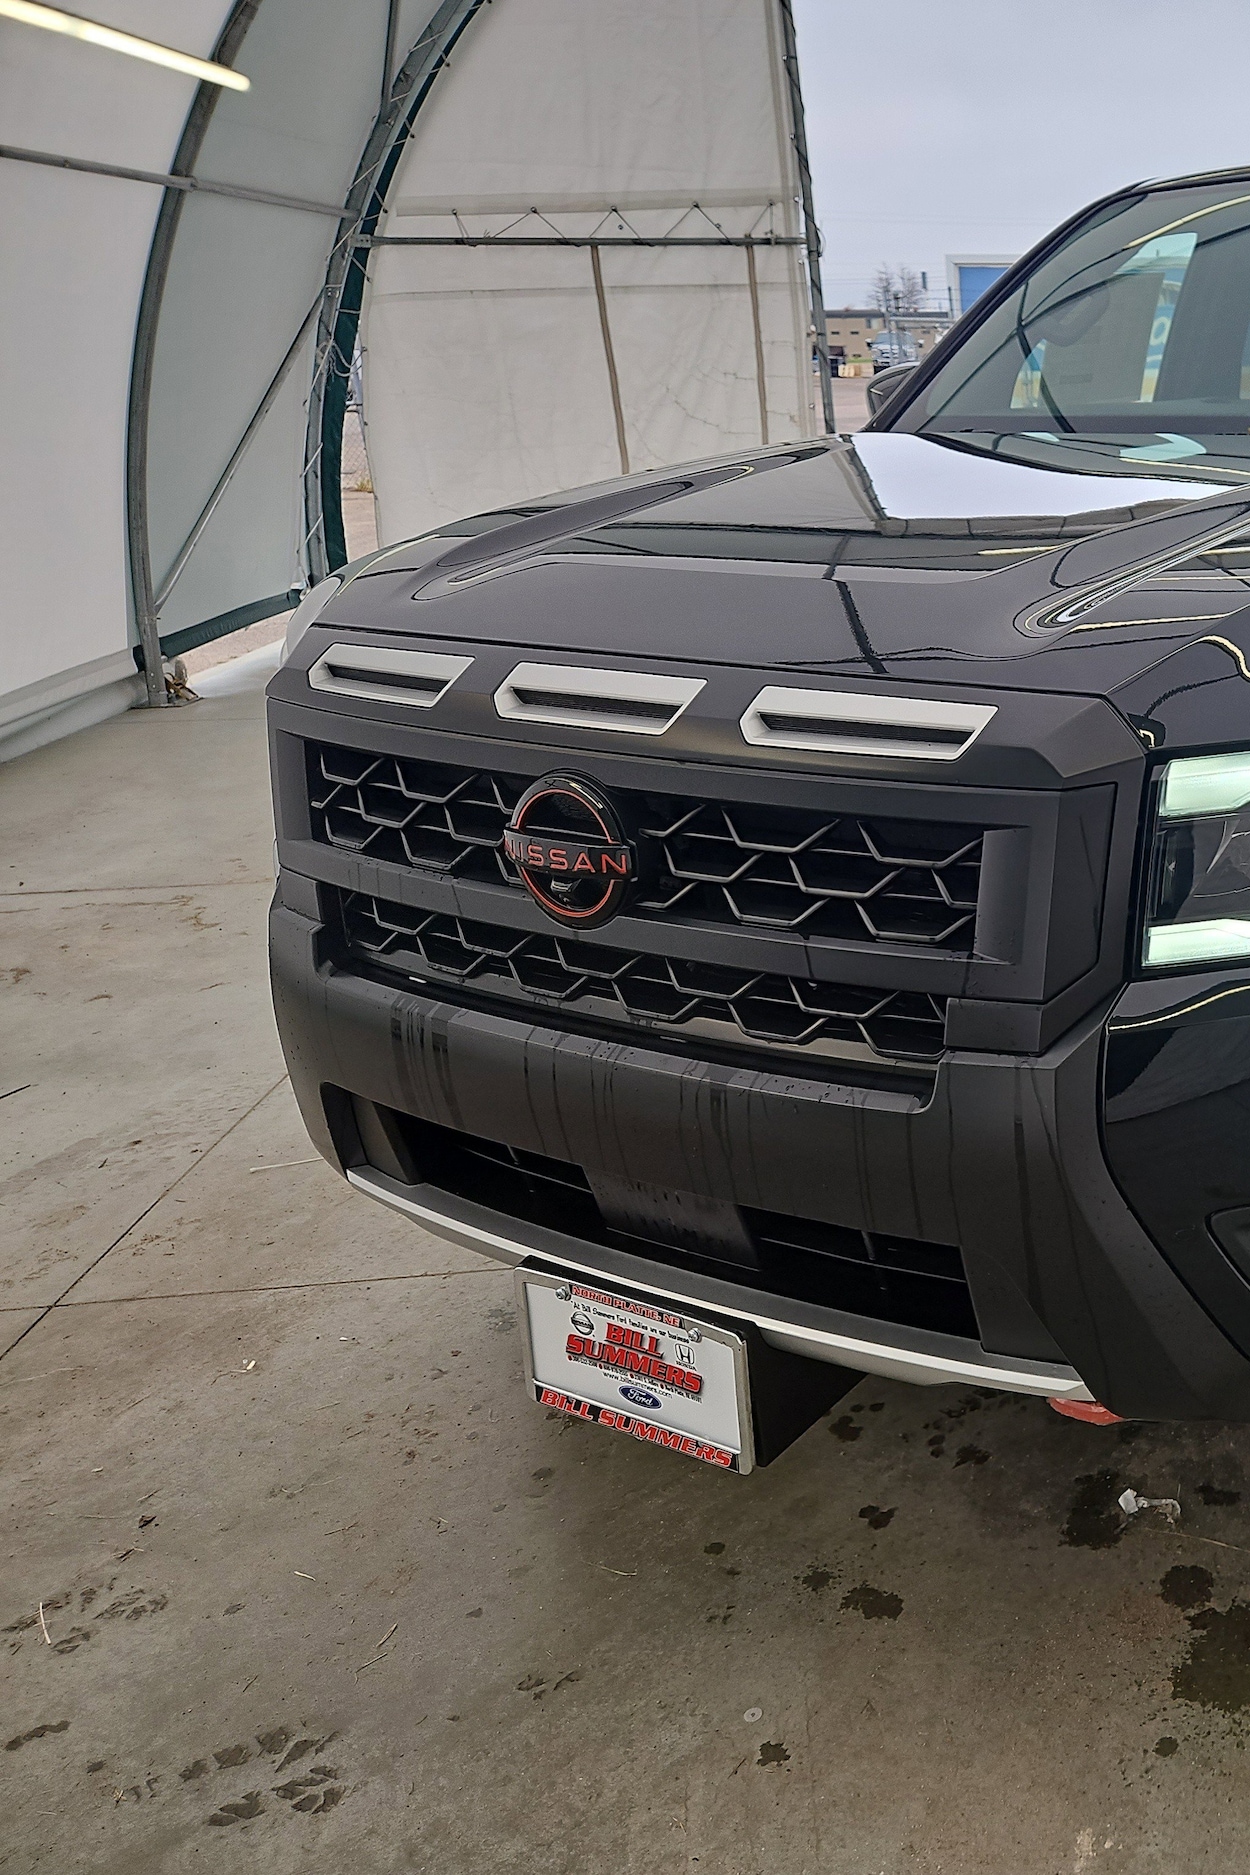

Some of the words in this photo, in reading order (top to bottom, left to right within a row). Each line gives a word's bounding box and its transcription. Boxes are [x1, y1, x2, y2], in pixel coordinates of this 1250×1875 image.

[504, 837, 627, 874] NISSAN
[572, 1285, 612, 1306] NORTH
[663, 1314, 681, 1327] NE
[605, 1322, 663, 1357] BILL
[566, 1333, 704, 1395] SUMMERS
[627, 1388, 656, 1408] Ford
[540, 1388, 593, 1420] BILL
[598, 1409, 732, 1468] SUMMERS
